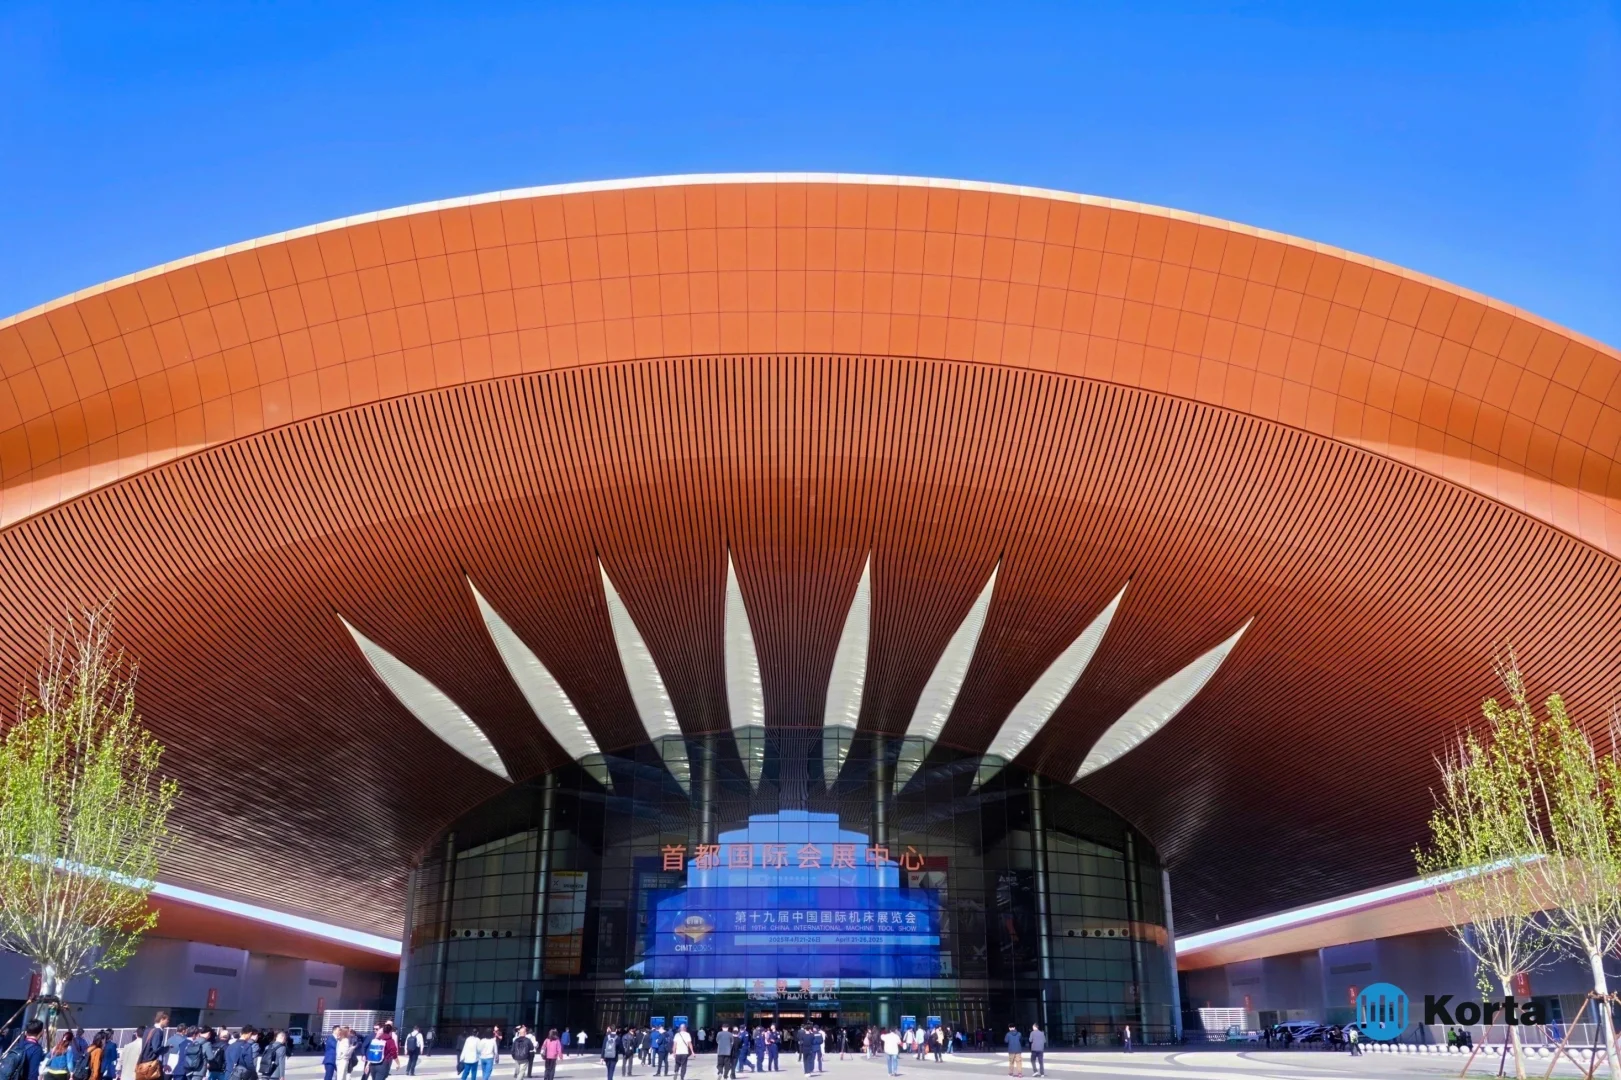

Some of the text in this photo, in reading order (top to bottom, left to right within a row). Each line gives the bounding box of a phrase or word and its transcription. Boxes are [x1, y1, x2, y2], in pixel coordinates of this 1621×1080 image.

[661, 843, 925, 871] 首都国际会展中心
[734, 910, 917, 924] 第十九届中国国际机床展览会
[835, 936, 849, 944] April
